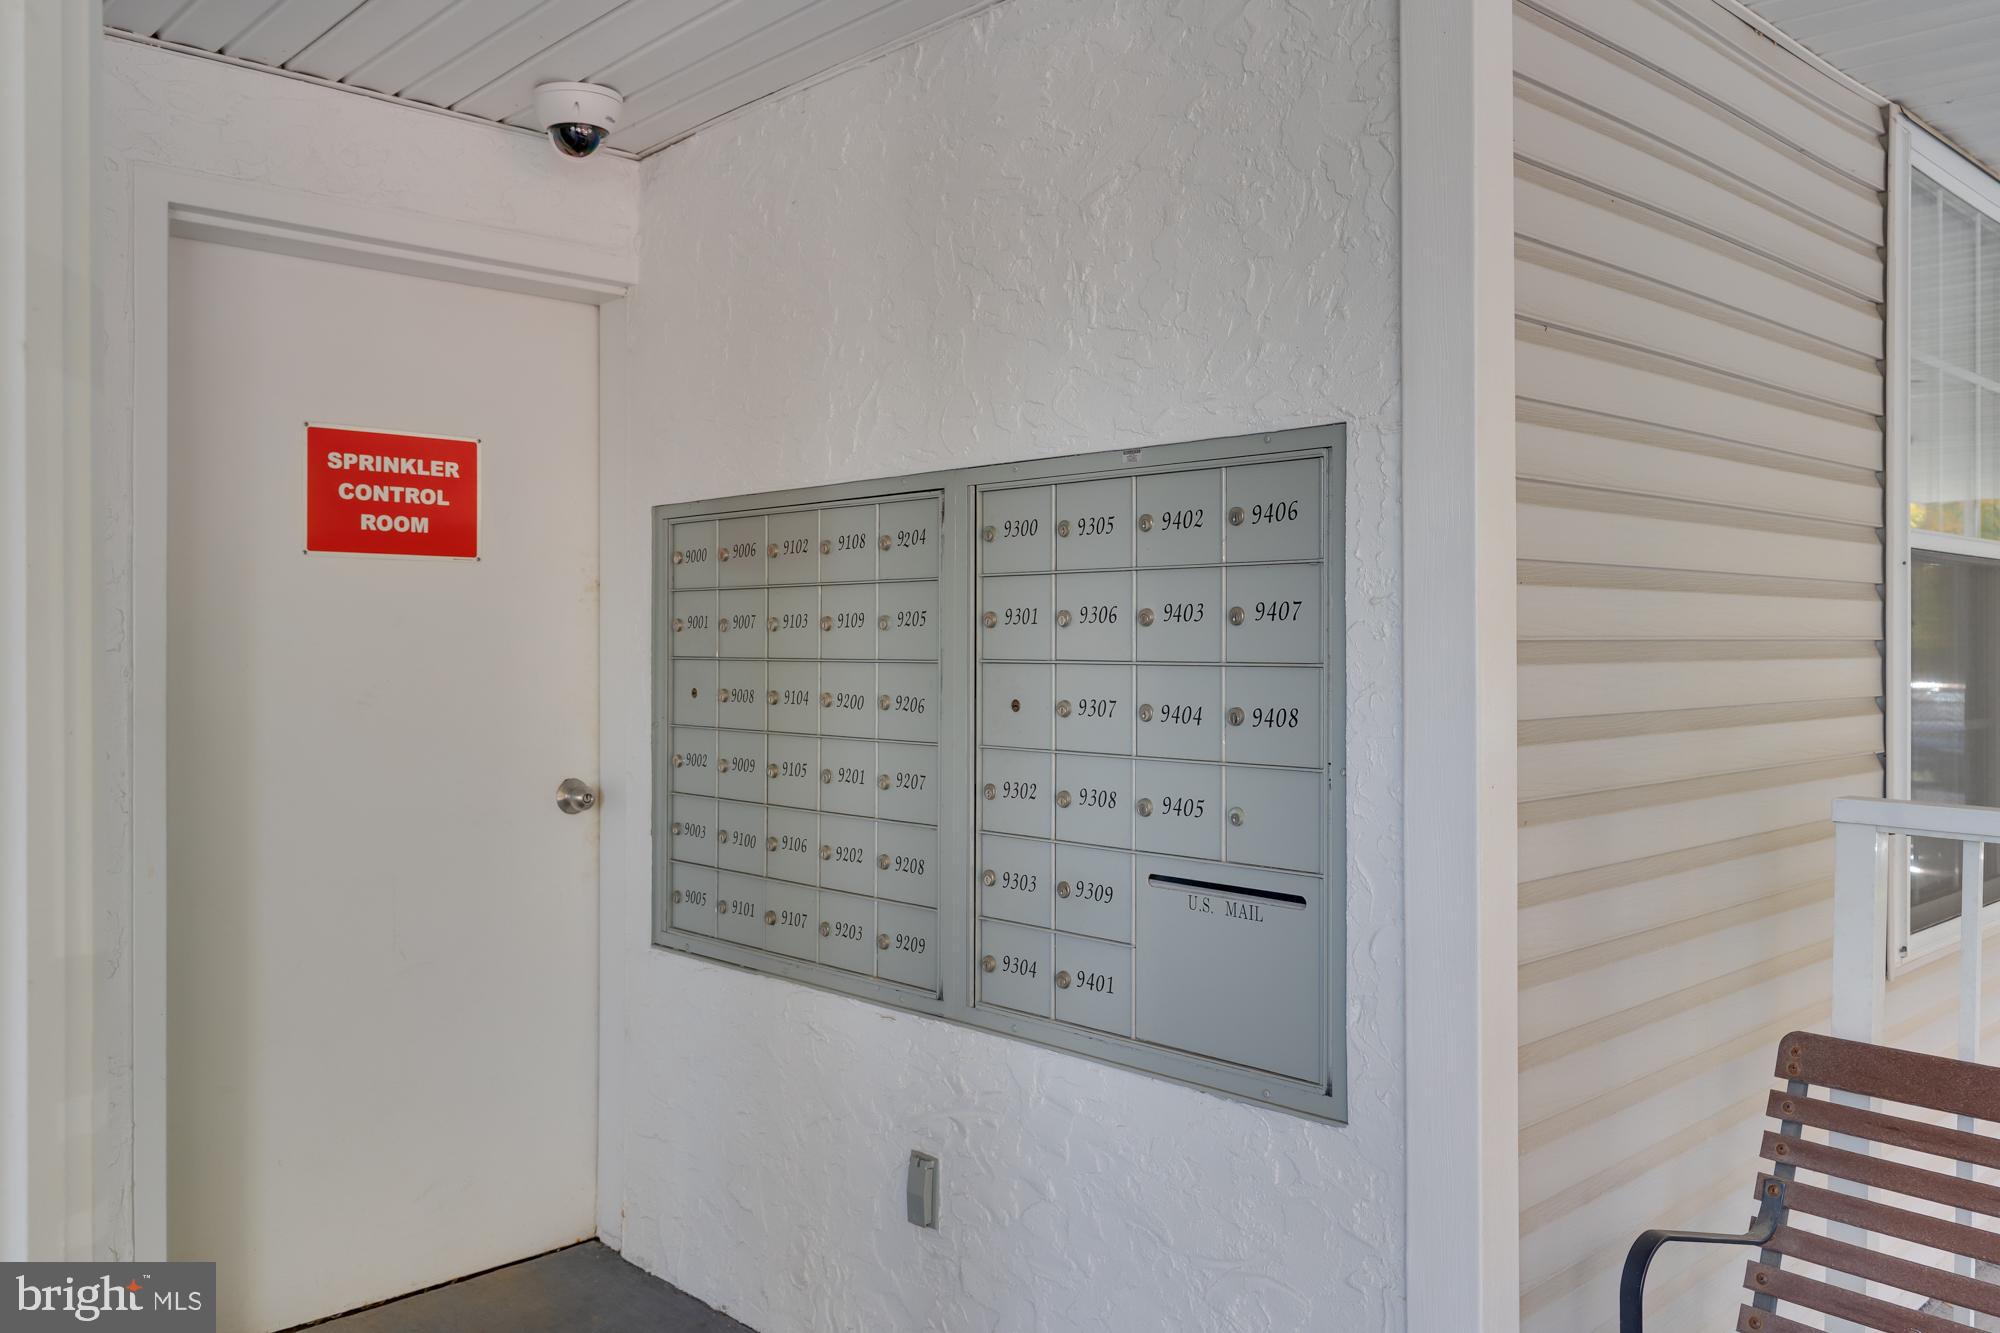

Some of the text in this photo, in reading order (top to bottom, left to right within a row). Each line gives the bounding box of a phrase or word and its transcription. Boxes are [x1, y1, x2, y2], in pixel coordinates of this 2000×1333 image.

[327, 452, 460, 478] SPRINKLER
[338, 483, 450, 505] CONTROL
[1162, 509, 1204, 531] 9402
[1252, 501, 1298, 524] 9406
[360, 514, 429, 533] ROOM
[1003, 519, 1038, 538] 9300
[1078, 516, 1115, 536] 9305
[783, 539, 808, 554] 9102
[838, 534, 866, 550] 9108
[897, 529, 926, 548] 9204
[685, 548, 707, 564] 9000
[732, 542, 756, 558] 9006
[897, 611, 926, 628] 9205
[1005, 608, 1038, 625] 9301
[1080, 606, 1118, 624] 9306
[1163, 603, 1204, 623] 9403
[1255, 601, 1302, 621] 9407
[688, 616, 708, 628] 9001
[732, 614, 756, 628] 9007
[783, 614, 808, 628] 9103
[838, 613, 864, 628] 9109
[731, 689, 754, 703] 9008
[784, 690, 809, 706] 9104
[836, 694, 864, 710] 9200
[895, 696, 925, 714] 9206
[1078, 699, 1116, 718] 9307
[1161, 705, 1202, 726] 9404
[1252, 708, 1298, 728] 9408
[686, 753, 708, 768] 9002
[732, 758, 755, 772] 9009
[782, 762, 807, 778] 9105
[838, 768, 864, 784] 9201
[896, 772, 926, 790] 9207
[1002, 781, 1037, 801] 9302
[1079, 788, 1117, 809] 9308
[1162, 796, 1204, 818] 9405
[684, 822, 706, 839] 9003
[733, 832, 756, 849] 9100
[782, 836, 807, 852] 9106
[836, 847, 863, 864] 9202
[895, 857, 924, 875] 9208
[1002, 872, 1037, 892] 9303
[685, 890, 706, 906] 9005
[1076, 881, 1113, 904] 9309
[732, 900, 754, 917] 9101
[1188, 894, 1264, 922] U.S. MAIL
[782, 911, 807, 928] 9107
[835, 922, 862, 941] 9203
[896, 934, 925, 954] 9209
[1002, 956, 1037, 978] 9304
[1077, 971, 1114, 994] 9401
